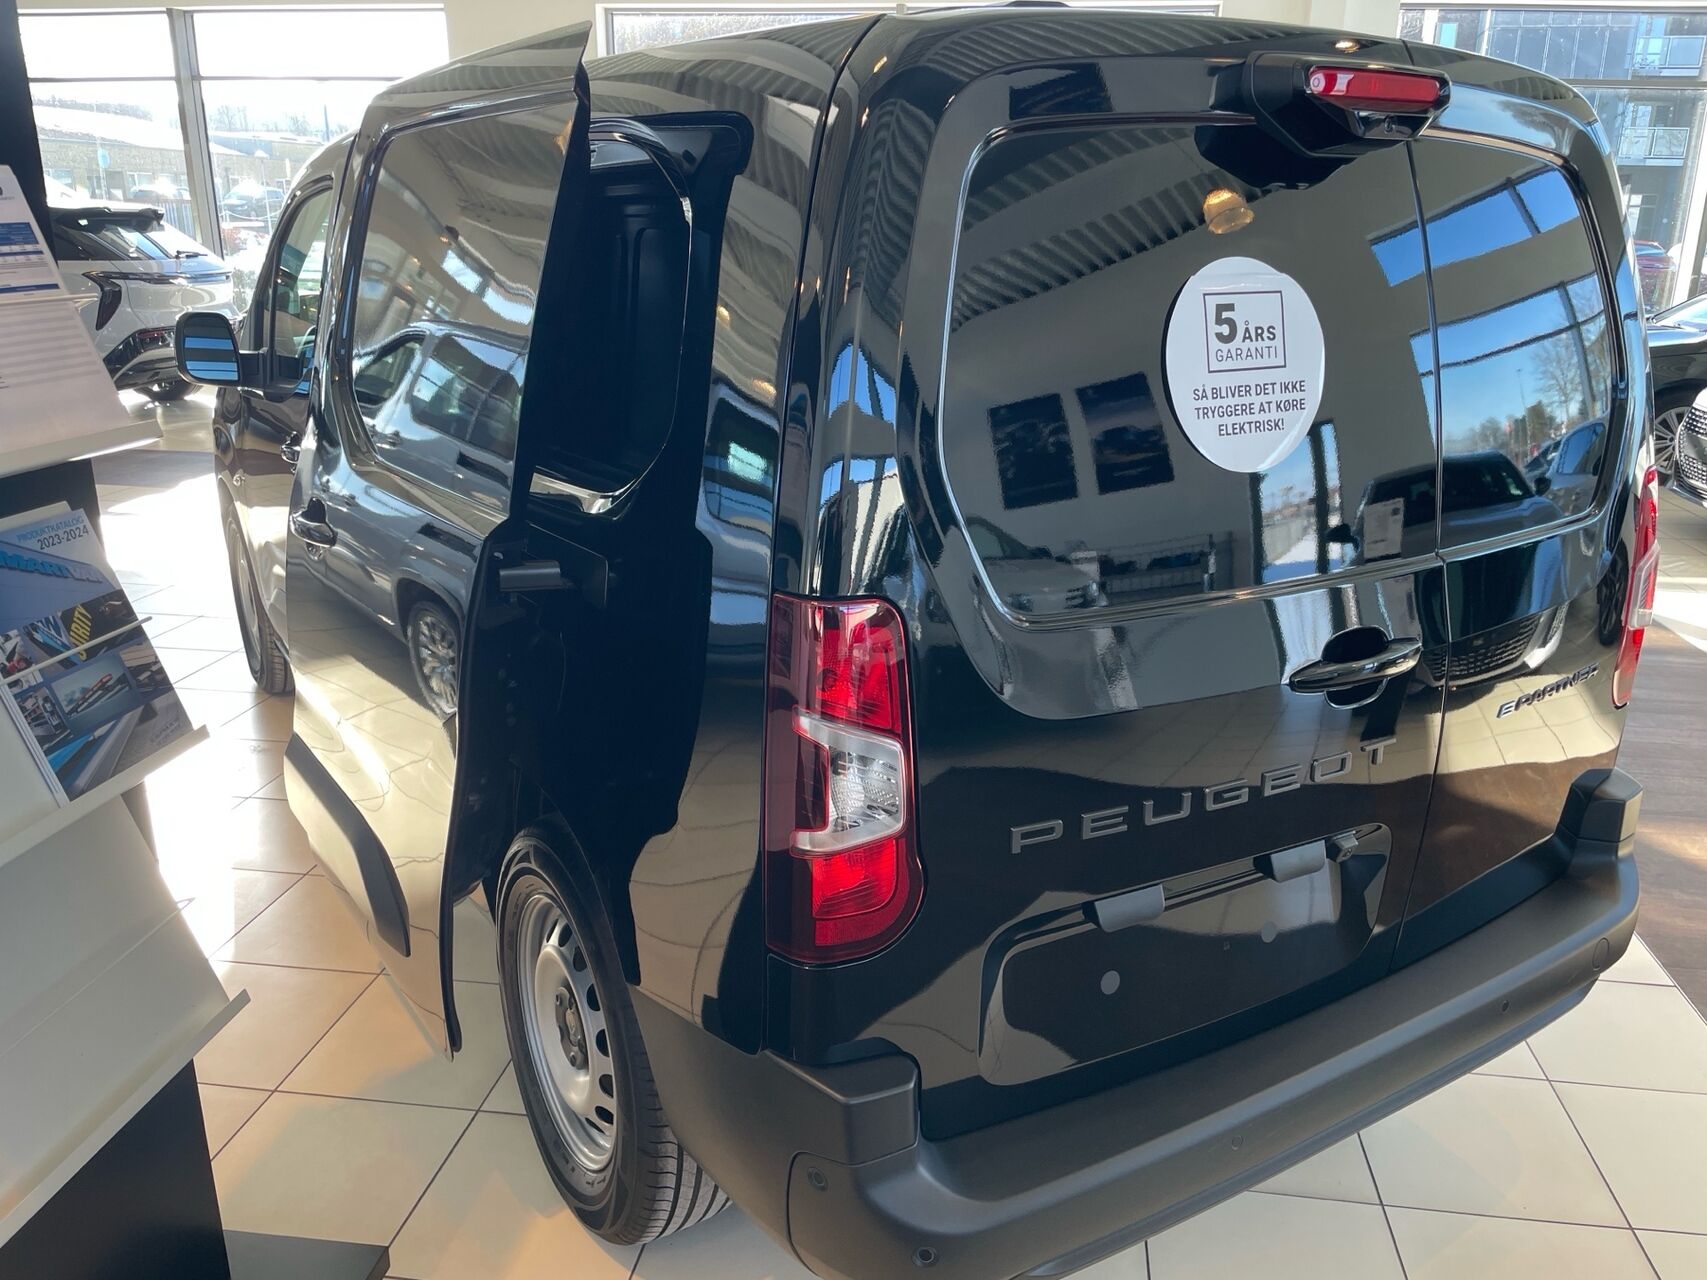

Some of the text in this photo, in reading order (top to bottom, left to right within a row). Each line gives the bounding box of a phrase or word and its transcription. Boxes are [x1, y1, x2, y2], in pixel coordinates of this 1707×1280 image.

[1214, 303, 1277, 344] 5 ÅRS
[1215, 346, 1278, 363] GARANTI
[1192, 380, 1306, 401] SÅ BLIVER DET IKKE
[1194, 398, 1306, 420] TRYGGERE AT KØRE
[1218, 418, 1285, 437] ELEKTRISK!
[37, 524, 89, 550] 2023-2024
[1010, 738, 1397, 855] PEUGEOT
